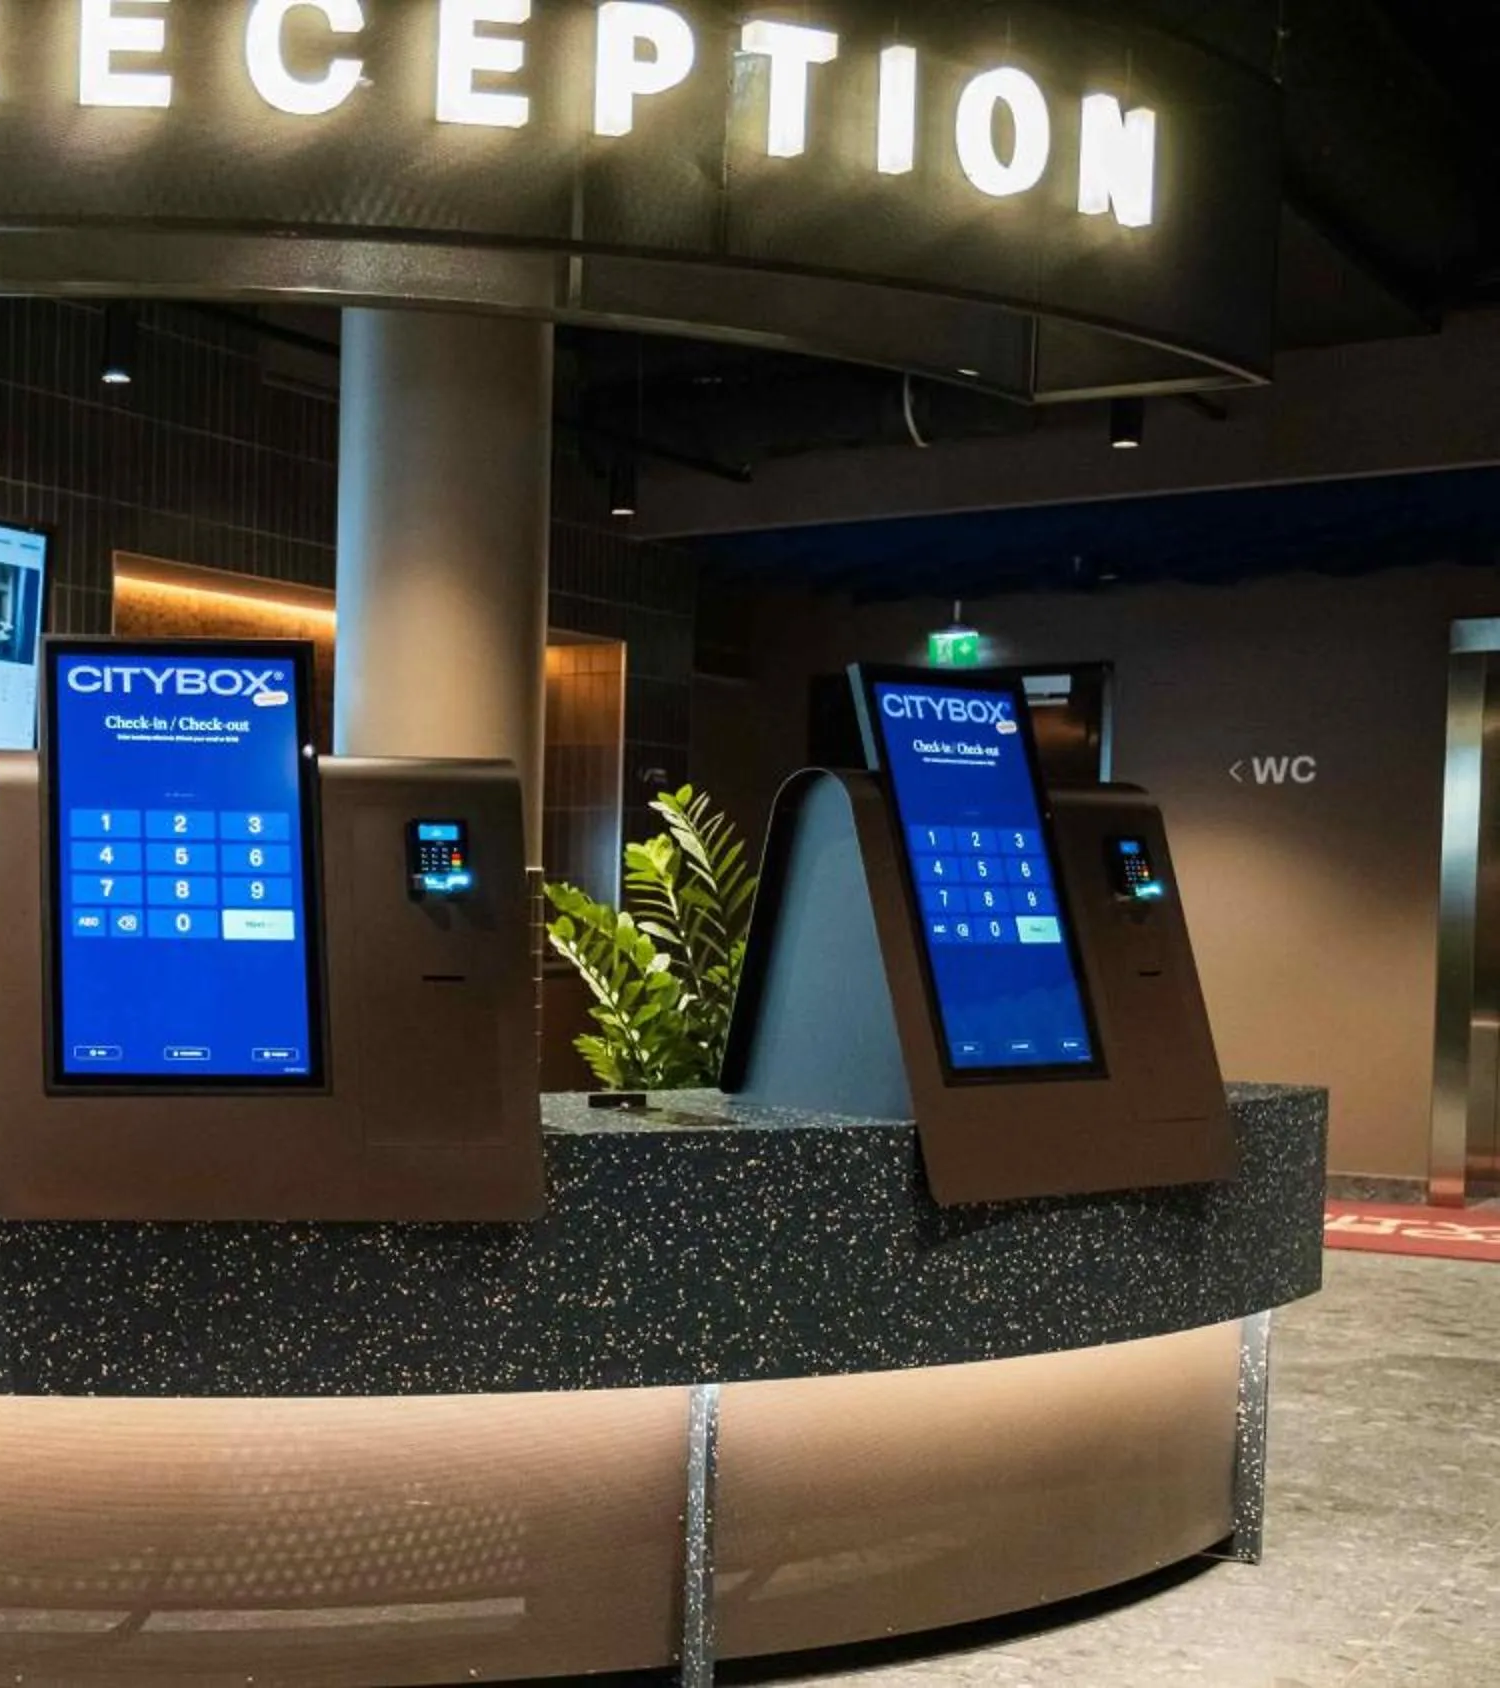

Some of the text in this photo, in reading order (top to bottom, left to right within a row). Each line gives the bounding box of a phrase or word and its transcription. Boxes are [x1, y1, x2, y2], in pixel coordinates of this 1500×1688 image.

[105, 715, 168, 731] Check-in
[179, 716, 250, 732] Check-out
[1252, 755, 1317, 784] WC
[101, 813, 262, 834] 1 2 3
[928, 829, 1025, 849] 1 2 3
[99, 847, 263, 867] 4 5 6
[933, 860, 943, 876] 4
[977, 860, 987, 877] 5
[100, 879, 265, 899] 7 8 9
[938, 889, 948, 907] 7
[983, 891, 994, 907] 8
[175, 913, 191, 932] 0
[990, 921, 1001, 937] 0
